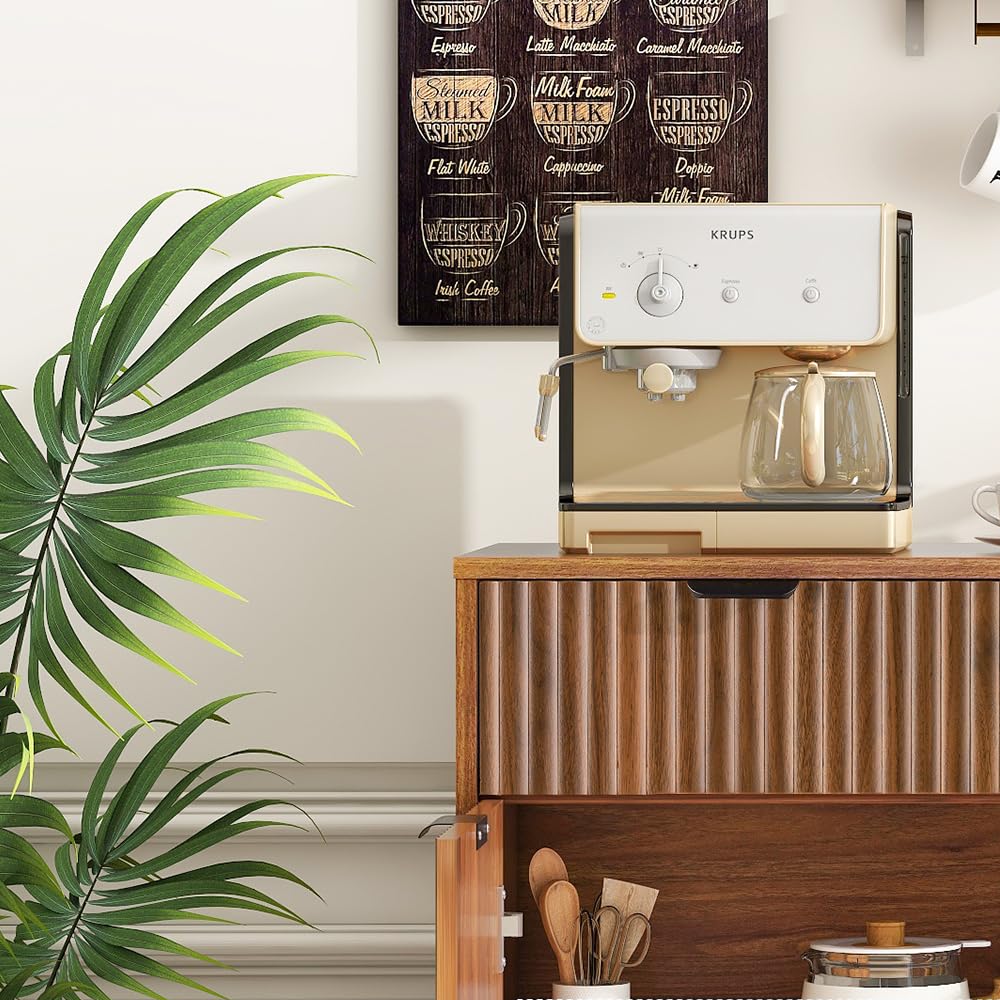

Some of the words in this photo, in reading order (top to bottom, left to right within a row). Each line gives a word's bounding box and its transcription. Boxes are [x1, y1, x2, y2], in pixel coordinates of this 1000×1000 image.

[421, 4, 482, 25] ESPRESSO
[541, 3, 602, 22] MILK
[660, 6, 720, 26] ESPRESSO
[431, 36, 477, 58] Espresso
[526, 35, 555, 52] Latte
[560, 35, 617, 52] Macchiato
[636, 37, 683, 54] Caramel
[687, 37, 744, 54] Macchiato
[416, 78, 492, 100] Steamed
[535, 76, 575, 98] Milk
[576, 76, 615, 98] Foam
[421, 101, 489, 120] MILK
[540, 104, 606, 122] MILK
[653, 98, 728, 121] ESPRESSO
[423, 123, 486, 144] ESPRESSO
[542, 125, 604, 146] ESPRESSO
[660, 125, 721, 146] ESPRESSO
[427, 158, 456, 175] Flat
[458, 158, 491, 175] White
[543, 155, 605, 178] Cappuccino
[675, 157, 714, 179] Doppio
[424, 220, 506, 242] WHISKEY
[711, 229, 754, 240] KRUPS
[433, 248, 495, 268] ESPRESSO
[435, 279, 461, 297] Irish
[464, 279, 501, 297] Coffee
